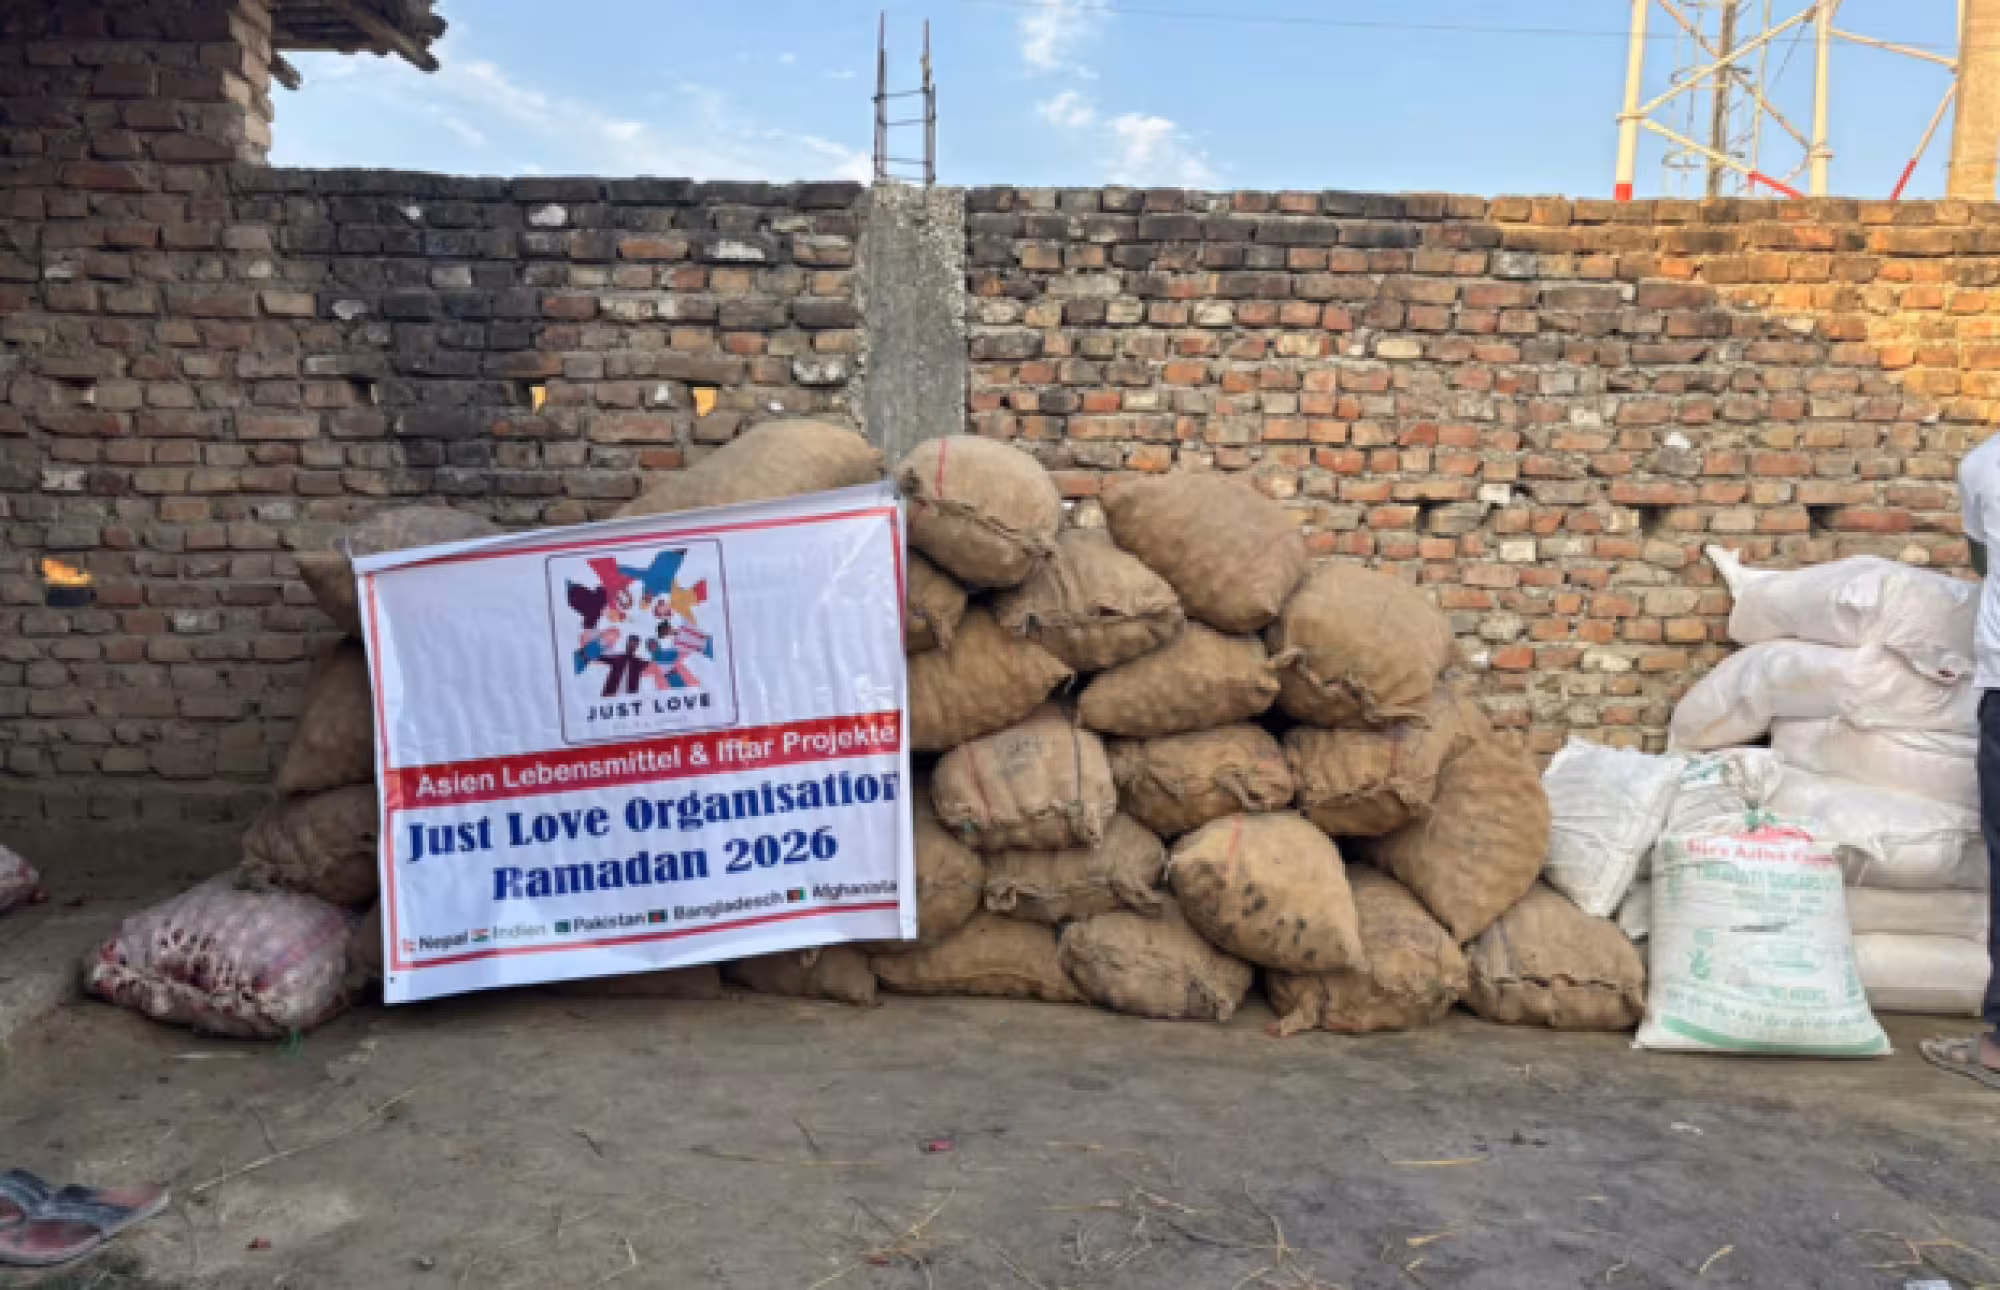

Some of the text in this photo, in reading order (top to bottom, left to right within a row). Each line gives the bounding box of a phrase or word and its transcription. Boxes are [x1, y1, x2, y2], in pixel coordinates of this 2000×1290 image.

[587, 693, 710, 722] JUST LOVE
[415, 722, 898, 798] Asien Lebensmittel & Iftar Projekte
[407, 816, 494, 864] Just
[506, 807, 611, 848] Love
[492, 825, 839, 901] Ramadan 2026
[419, 880, 898, 951] Nepal Indien Pakistan Bangladesch Afghanista
